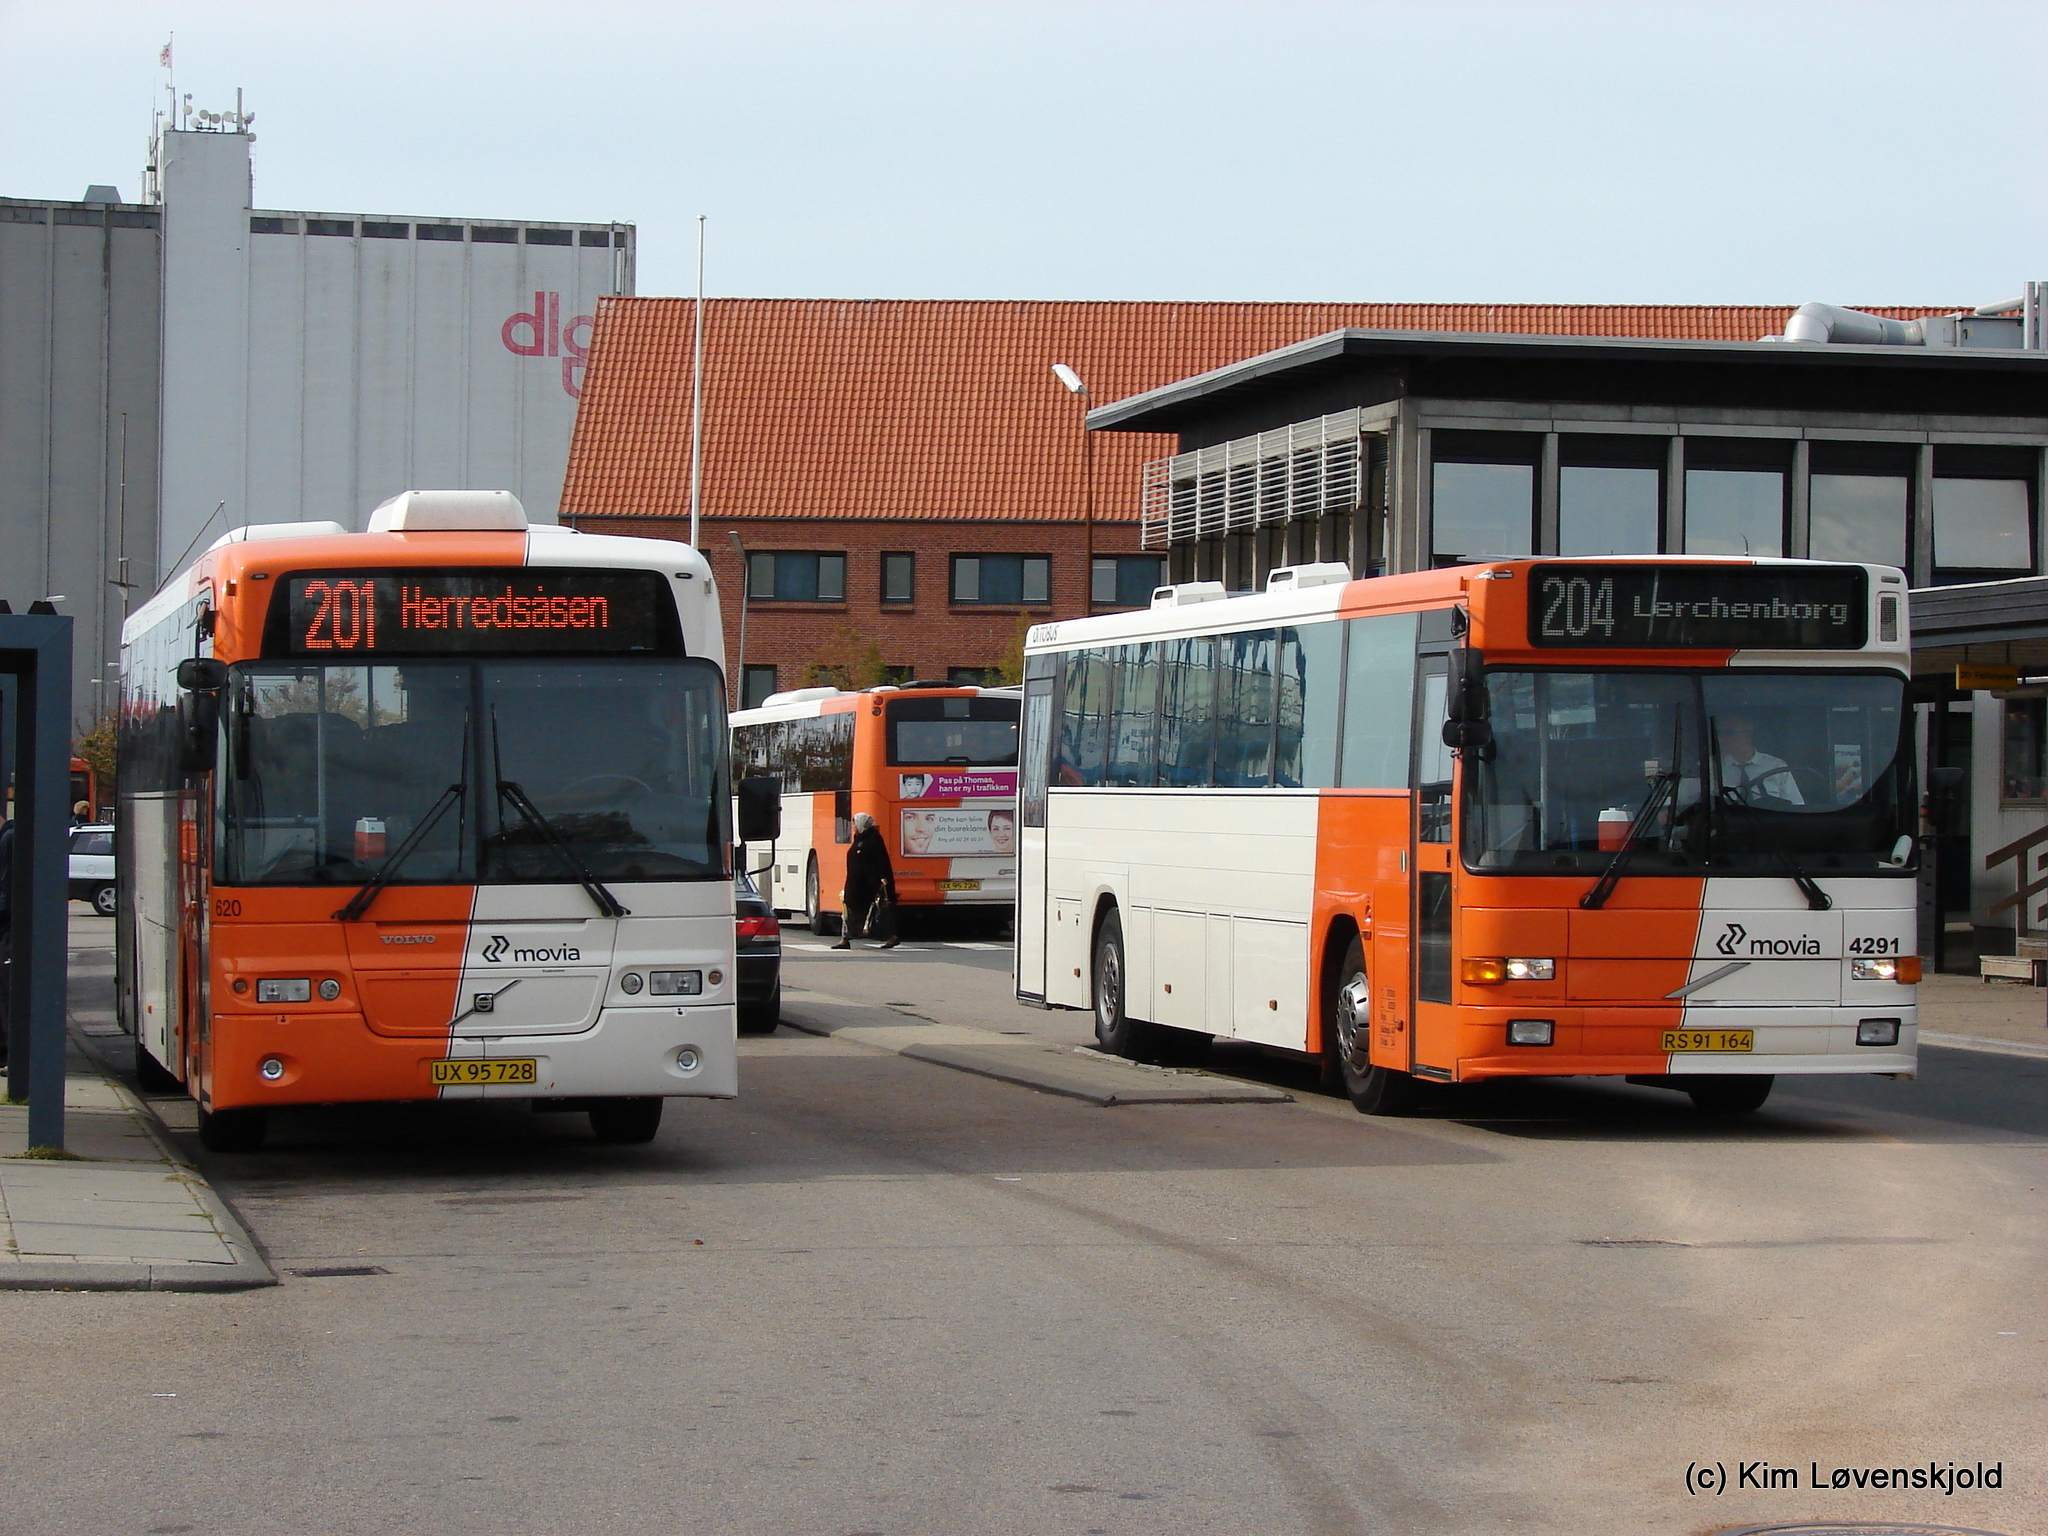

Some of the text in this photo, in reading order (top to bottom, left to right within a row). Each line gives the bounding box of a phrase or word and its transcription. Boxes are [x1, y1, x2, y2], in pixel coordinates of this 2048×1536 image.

[305, 580, 608, 649] 201 Herredsåsen
[1541, 577, 1848, 637] 204 Lerchenborg
[953, 776, 963, 786] på
[964, 776, 995, 785] Thomas,
[963, 786, 972, 794] ny
[976, 784, 1009, 792] trafikken
[215, 899, 242, 918] 620
[380, 934, 436, 945] VOLVO
[1750, 934, 1821, 956] movia
[1849, 937, 1900, 955] 4291
[513, 943, 581, 962] movia
[1664, 1033, 1750, 1049] RS 91 164
[435, 1063, 533, 1081] UX 95 728
